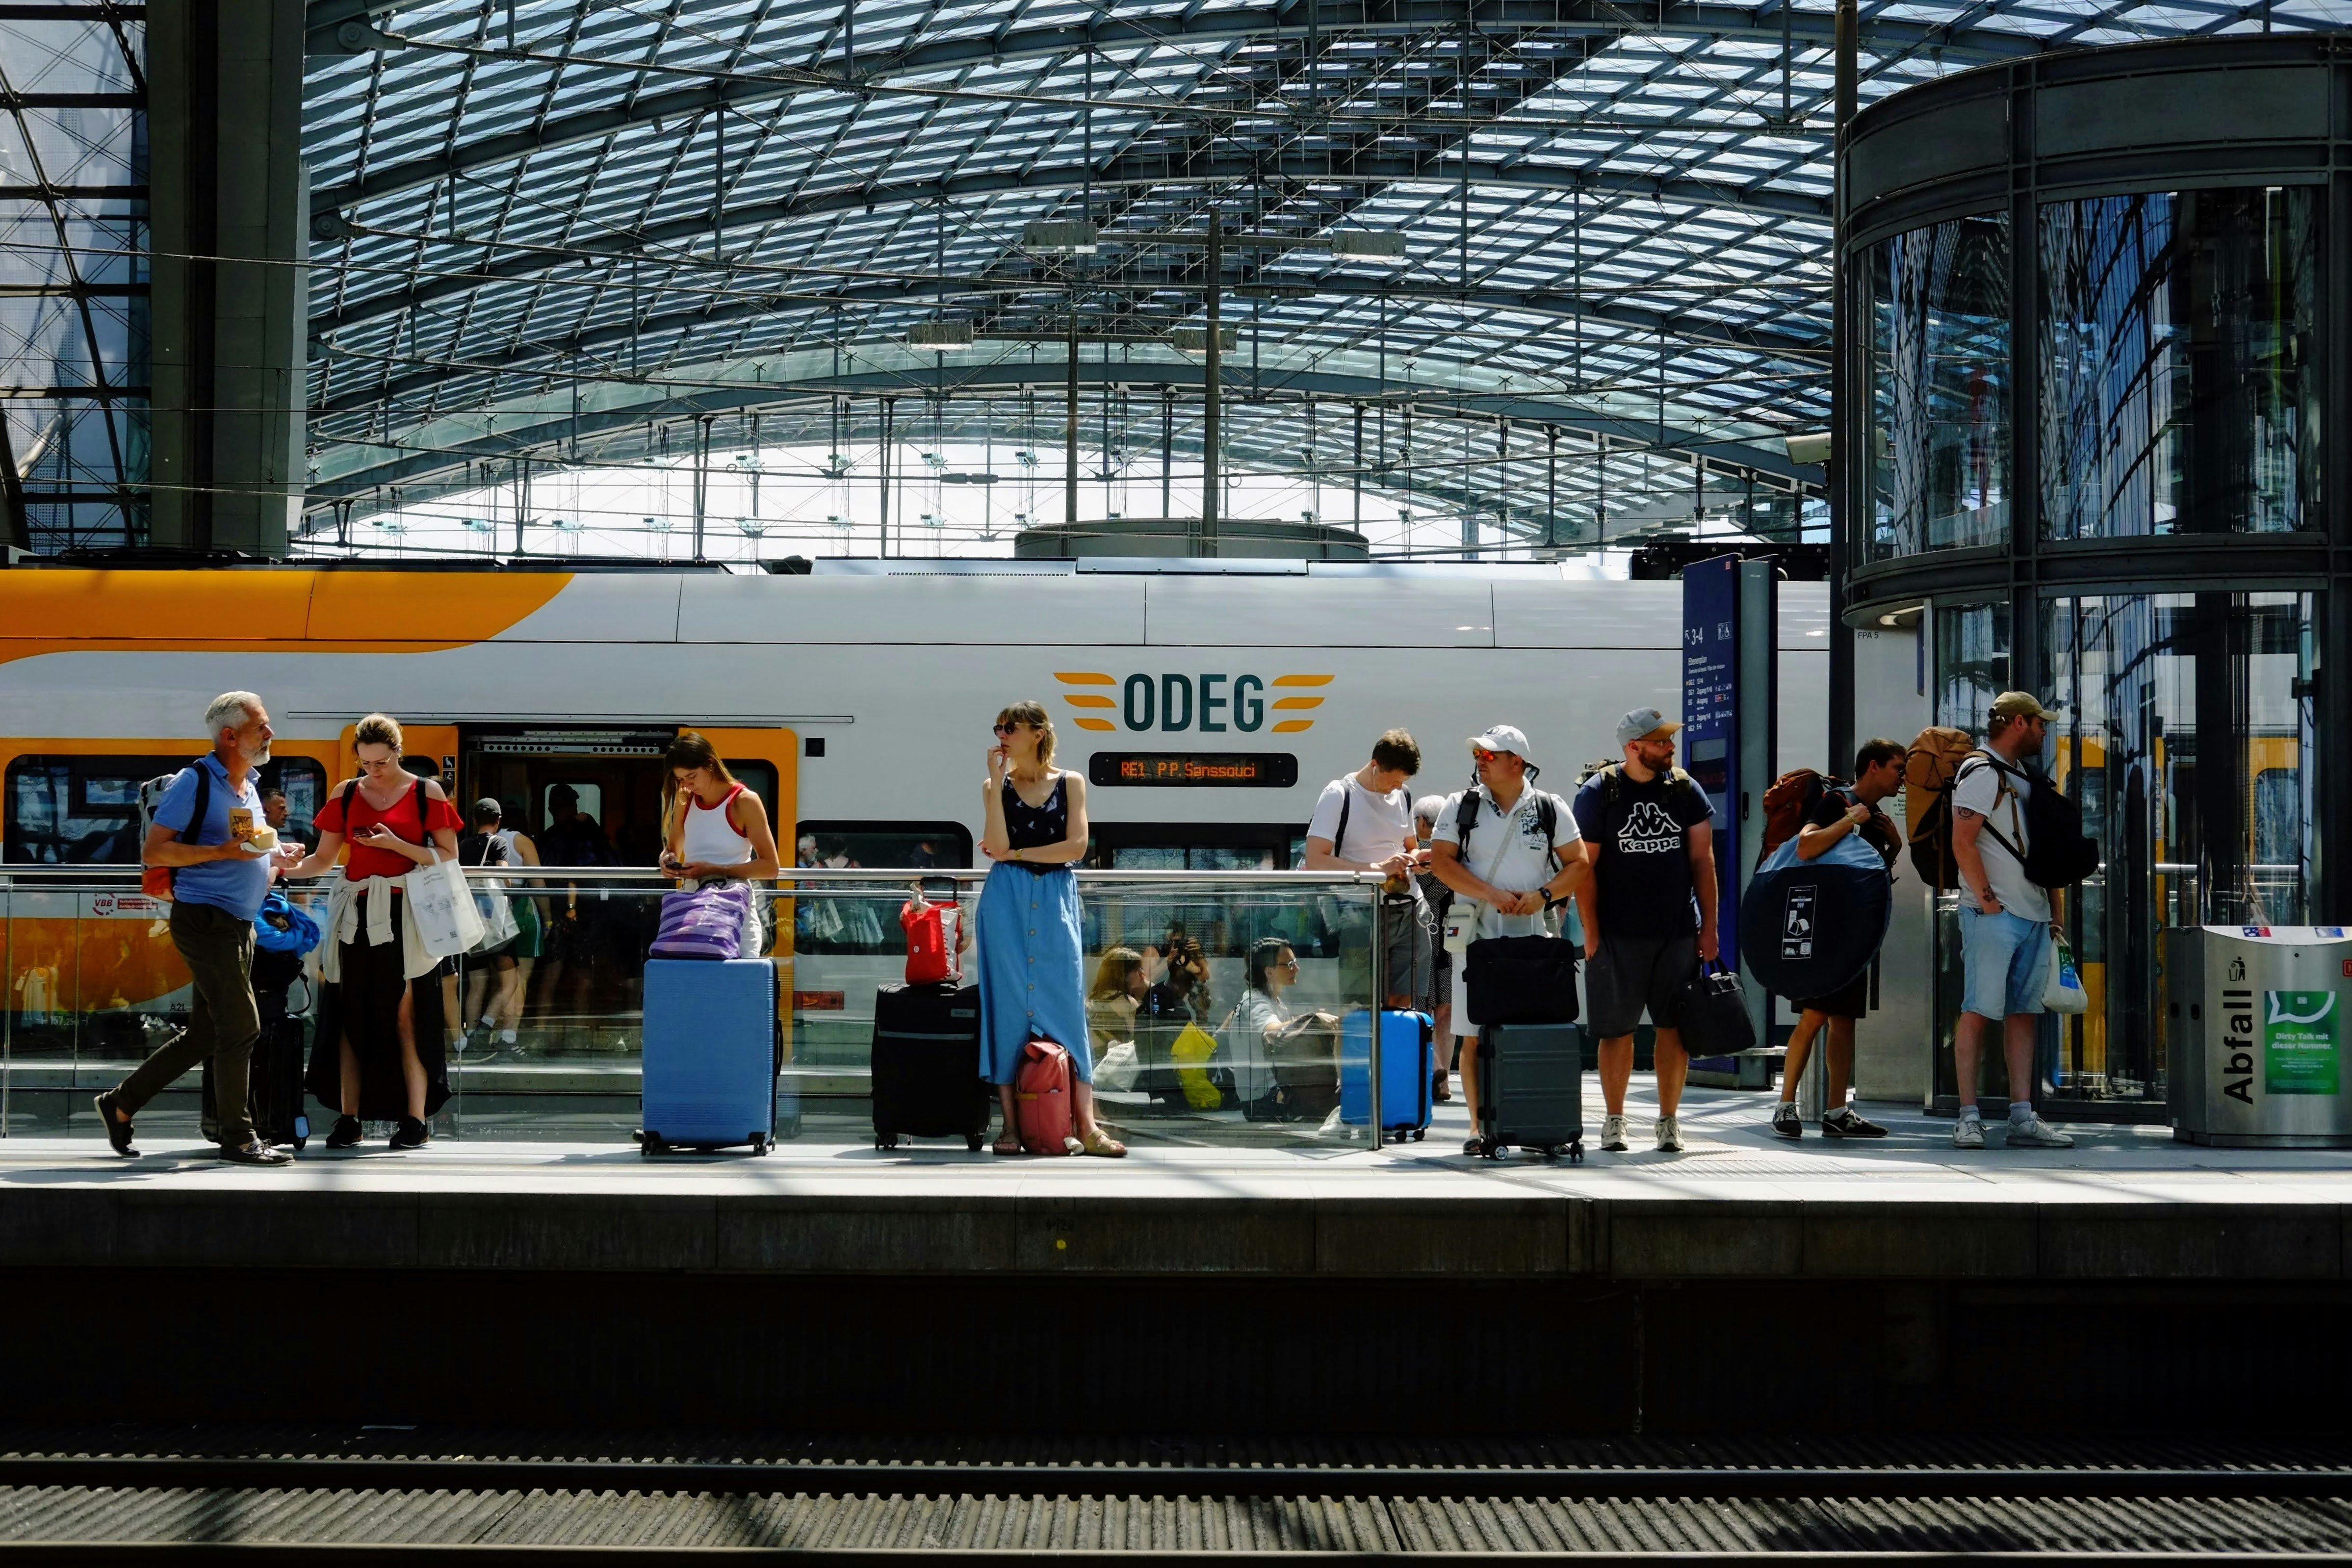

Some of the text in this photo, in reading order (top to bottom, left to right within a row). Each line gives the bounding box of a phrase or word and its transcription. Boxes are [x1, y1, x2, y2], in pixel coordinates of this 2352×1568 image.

[1691, 627, 1703, 645] 3-4
[1124, 673, 1264, 732] ODEG
[1121, 761, 1144, 777] RE1
[1619, 836, 1680, 853] Kappa
[169, 1003, 186, 1012] A2L
[2275, 1032, 2296, 1041] Dirty
[2223, 990, 2253, 1105] Abfall
